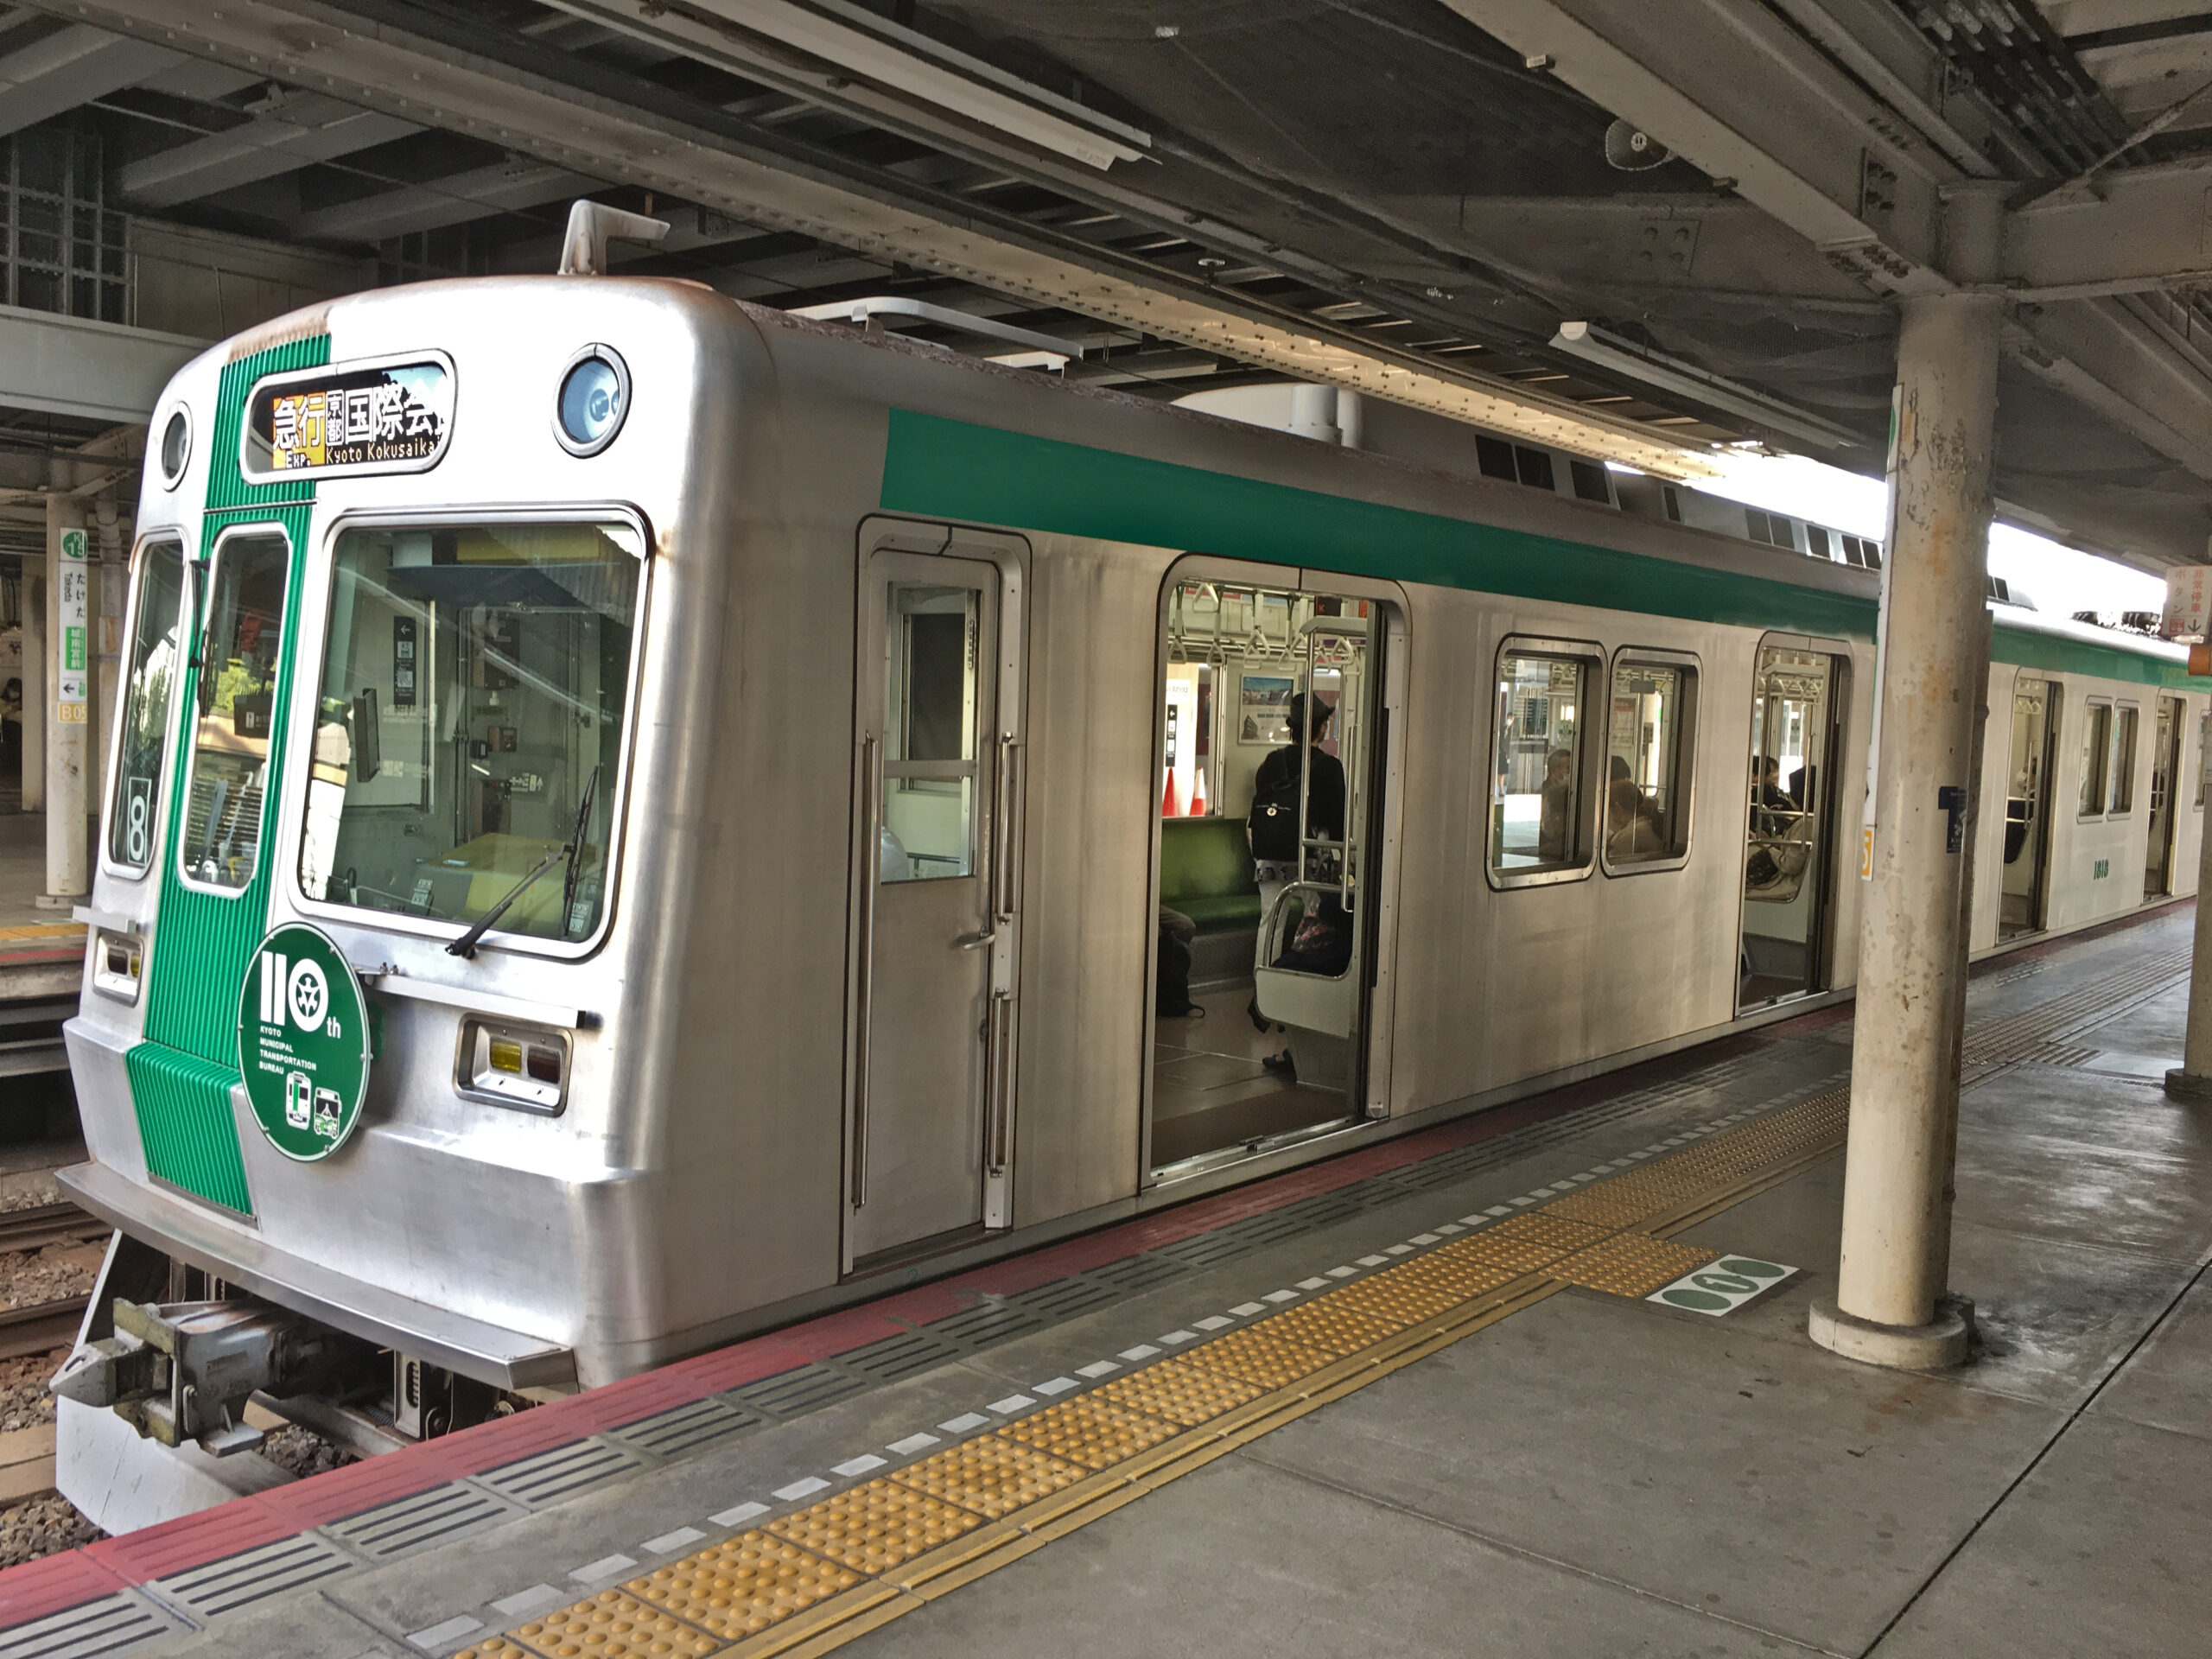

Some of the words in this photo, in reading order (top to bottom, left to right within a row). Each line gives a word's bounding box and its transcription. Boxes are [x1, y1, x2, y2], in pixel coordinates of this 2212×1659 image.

[273, 398, 325, 449] 急行
[326, 445, 362, 464] Kyoto
[367, 435, 441, 461] Kokusaika
[130, 794, 146, 861] 8
[2093, 857, 2109, 881] 1818
[260, 1026, 283, 1038] KYOTO
[259, 1037, 294, 1053] MUNICIPAL
[259, 1049, 317, 1071] TRANSPORTATION
[259, 1060, 284, 1075] BUREAU
